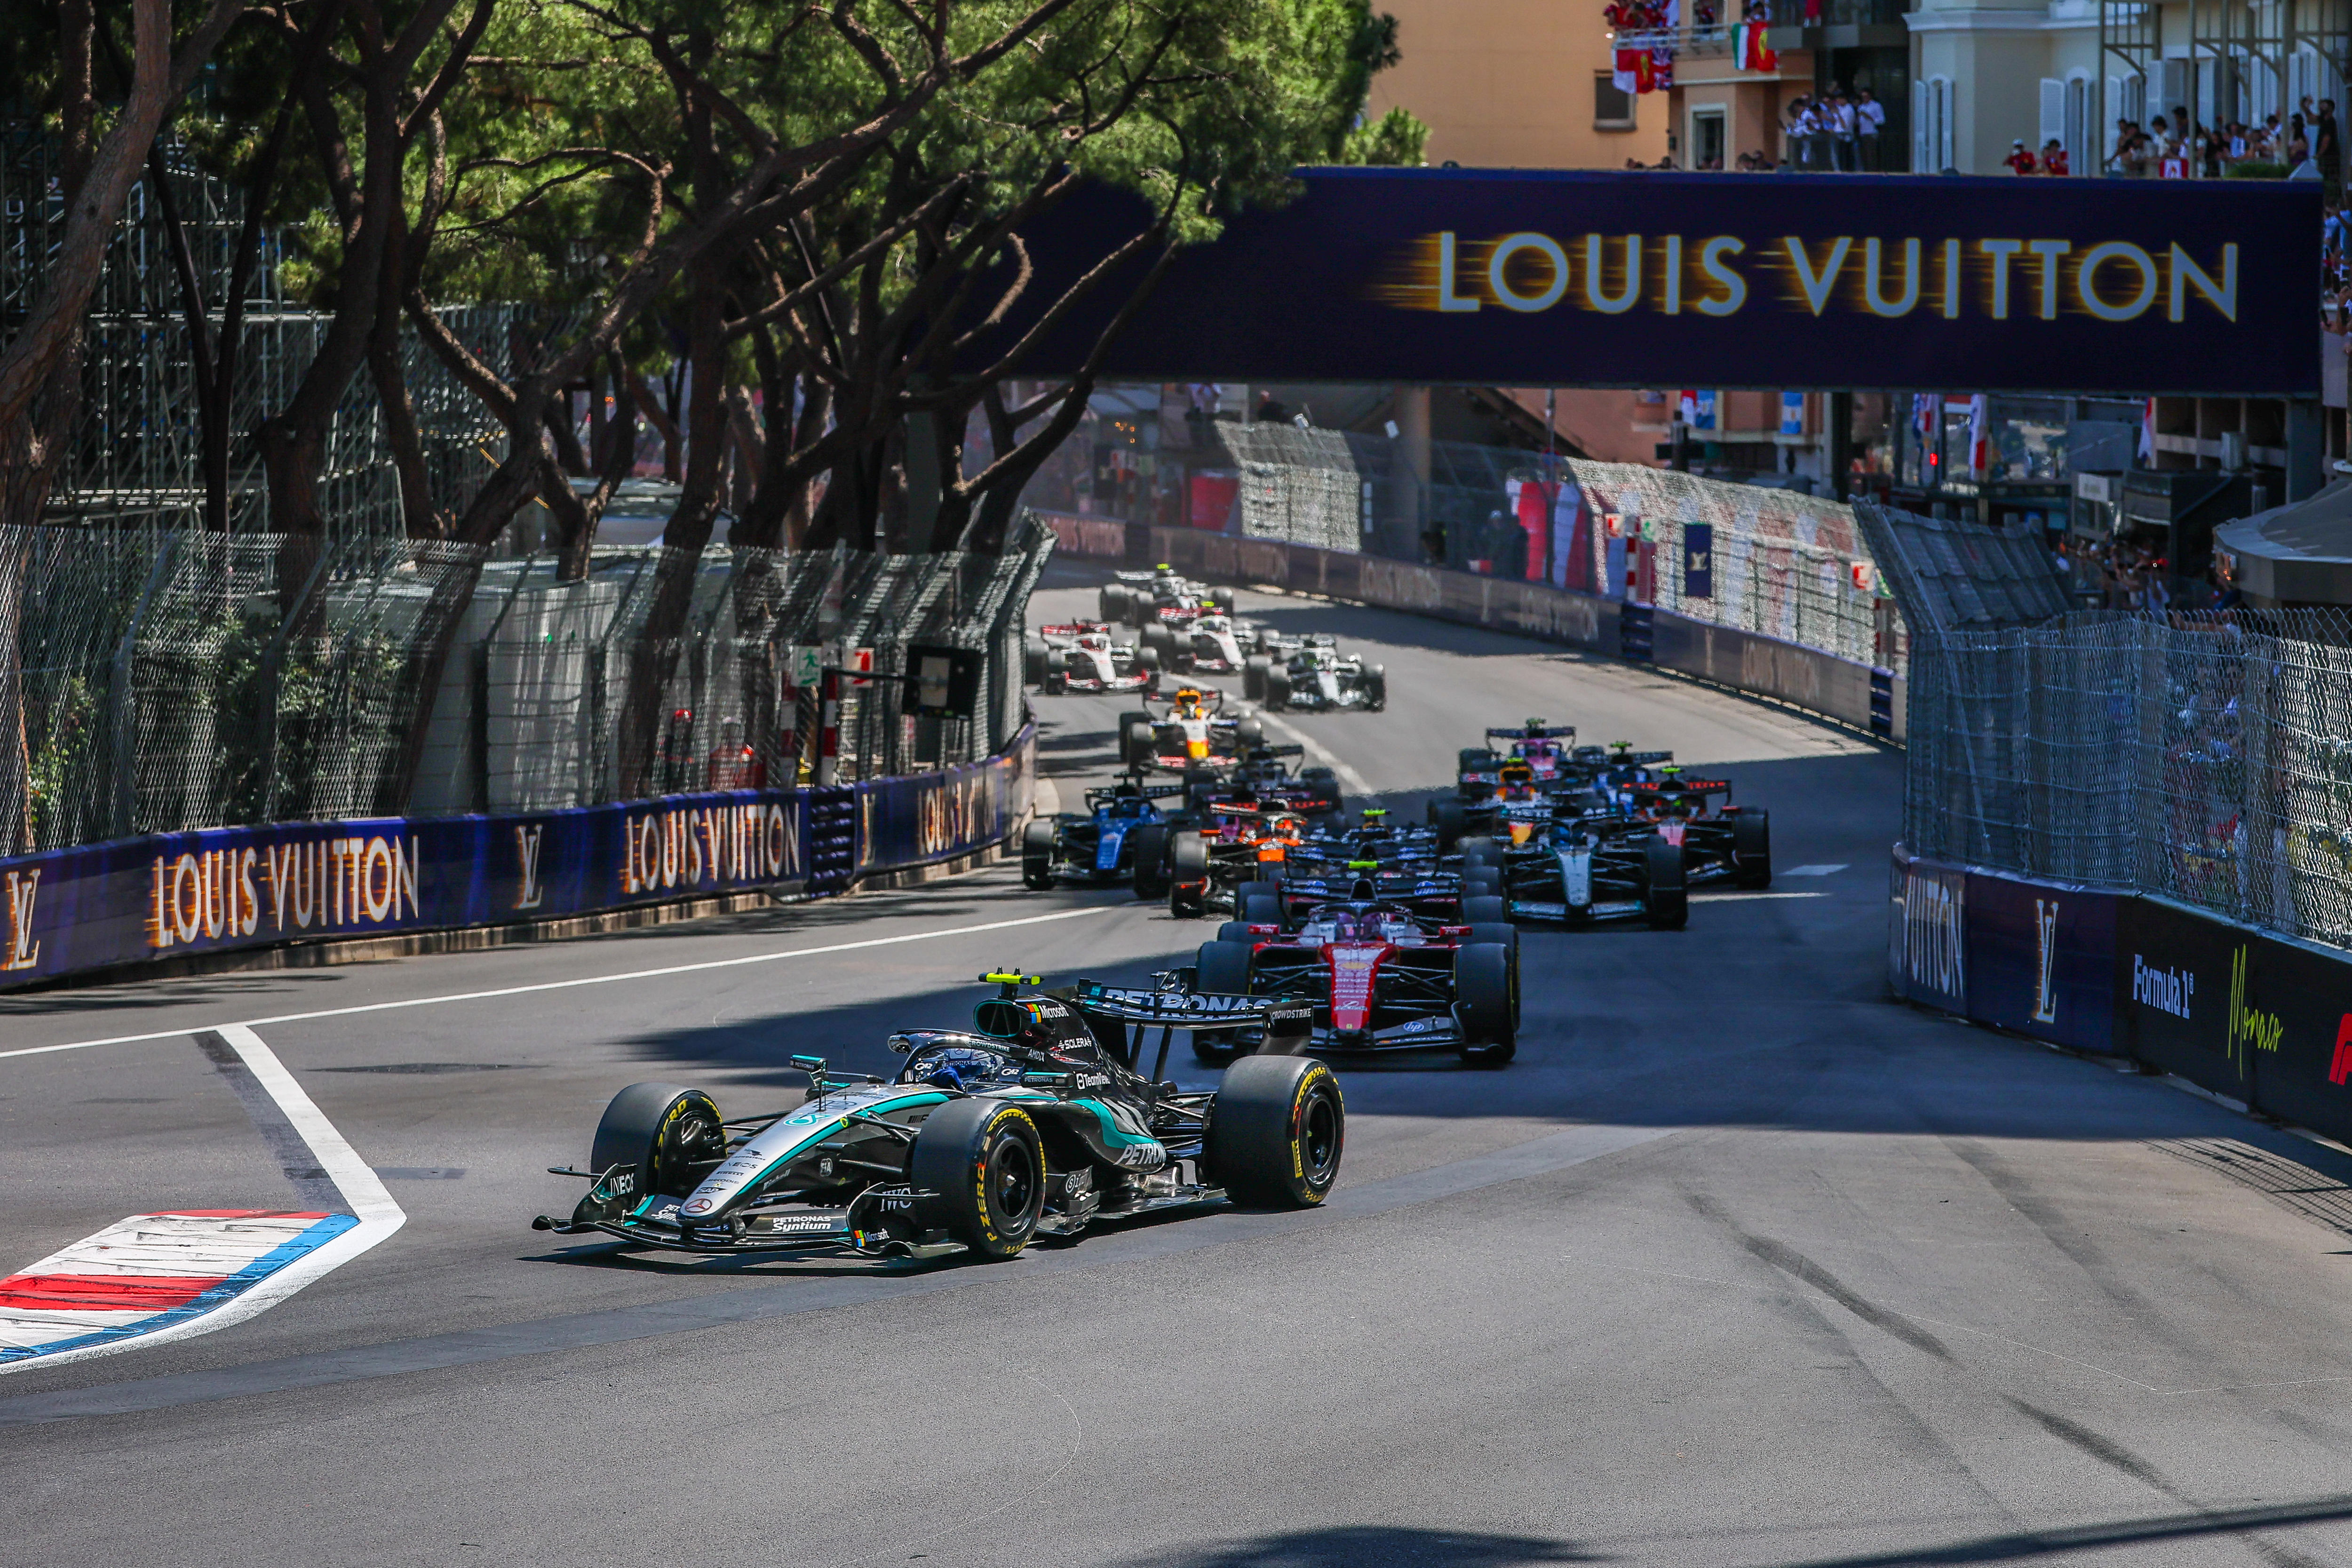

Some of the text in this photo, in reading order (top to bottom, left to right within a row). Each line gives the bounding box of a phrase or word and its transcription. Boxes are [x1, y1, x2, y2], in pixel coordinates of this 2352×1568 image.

[1438, 231, 2238, 323] LOUIS VUITTON
[626, 801, 801, 894] LOUIS VUITTON
[156, 835, 419, 947] LOUIS VUITTON
[2133, 954, 2181, 1016] Formula
[1039, 1003, 1069, 1019] Microsoft
[1103, 989, 1273, 1018] PETRONAS
[1271, 1007, 1312, 1020] CROWDSTRIKE
[2228, 944, 2283, 1082] Monaco
[968, 1040, 1010, 1052] CROWDSTRIKE
[1064, 1037, 1089, 1050] SOLERA
[1028, 1049, 1041, 1060] AMD
[880, 1187, 912, 1212] IWC
[771, 1221, 832, 1232] Syntium
[864, 1228, 890, 1242] Microsoft
